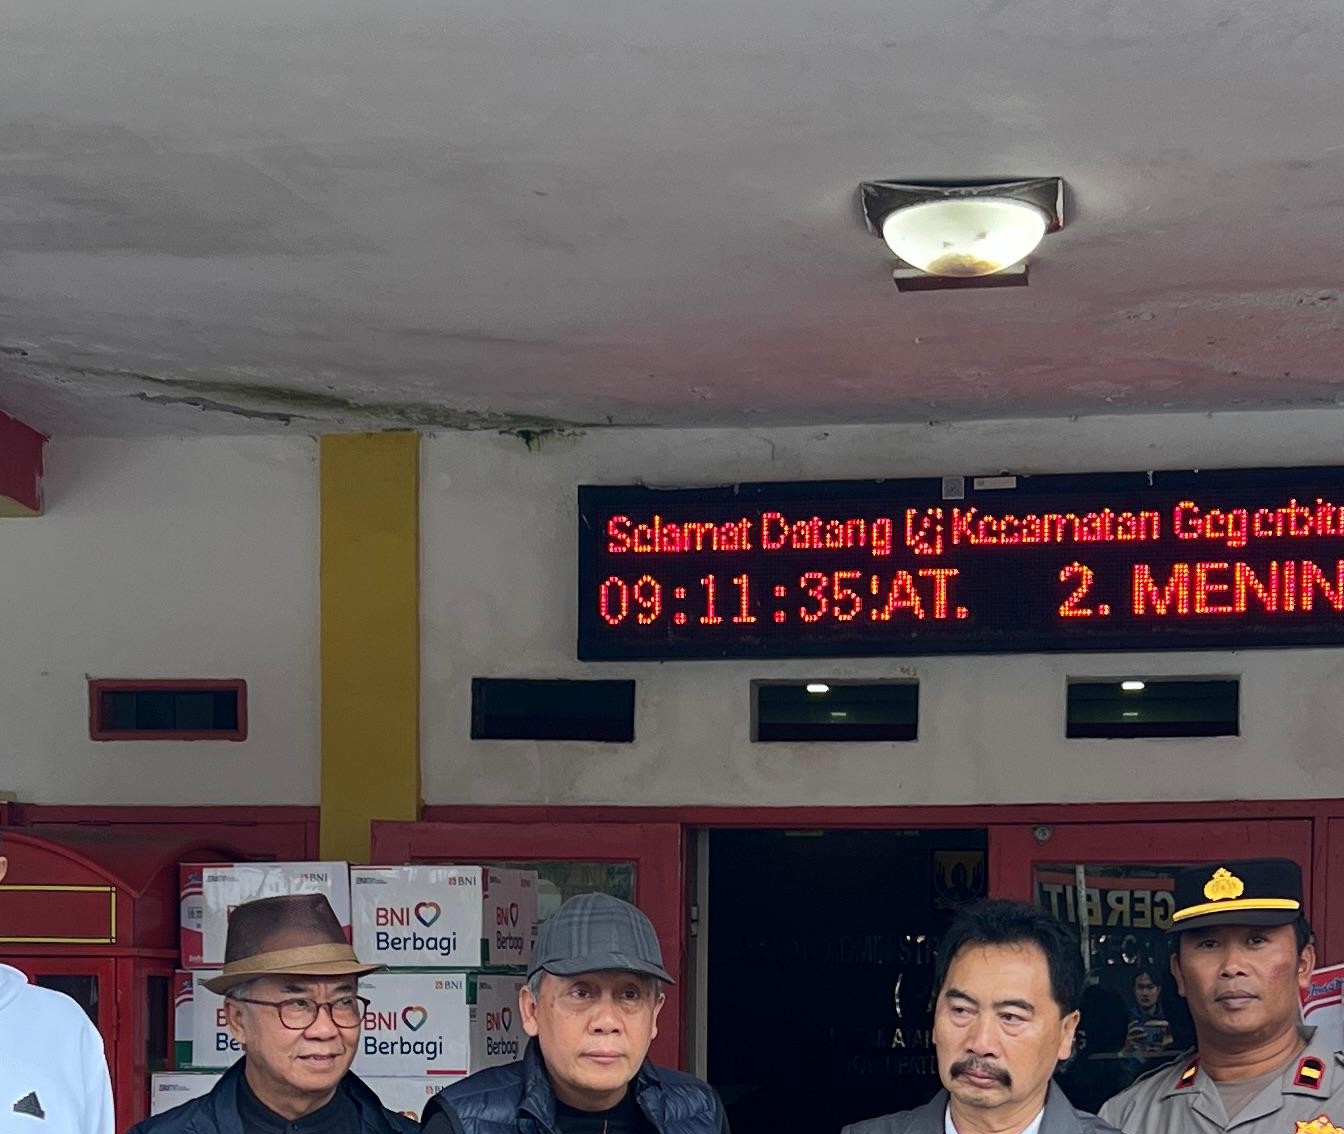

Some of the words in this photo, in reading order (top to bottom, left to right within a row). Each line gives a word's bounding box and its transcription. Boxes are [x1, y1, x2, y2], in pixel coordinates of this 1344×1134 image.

[607, 513, 753, 553] Selamat
[762, 511, 893, 556] Datang
[952, 506, 1161, 544] Kecamatan
[1059, 561, 1111, 618] 2.
[458, 877, 477, 886] BNI
[376, 907, 410, 927] BNI
[496, 906, 509, 926] BNI
[376, 931, 457, 956] Berbagi
[496, 931, 524, 955] Berbagi
[444, 980, 463, 990] BNI
[364, 1011, 397, 1031] BNI
[486, 1012, 501, 1031] BNI
[364, 1035, 443, 1061] Berbagi
[487, 1036, 519, 1060] Berbagi
